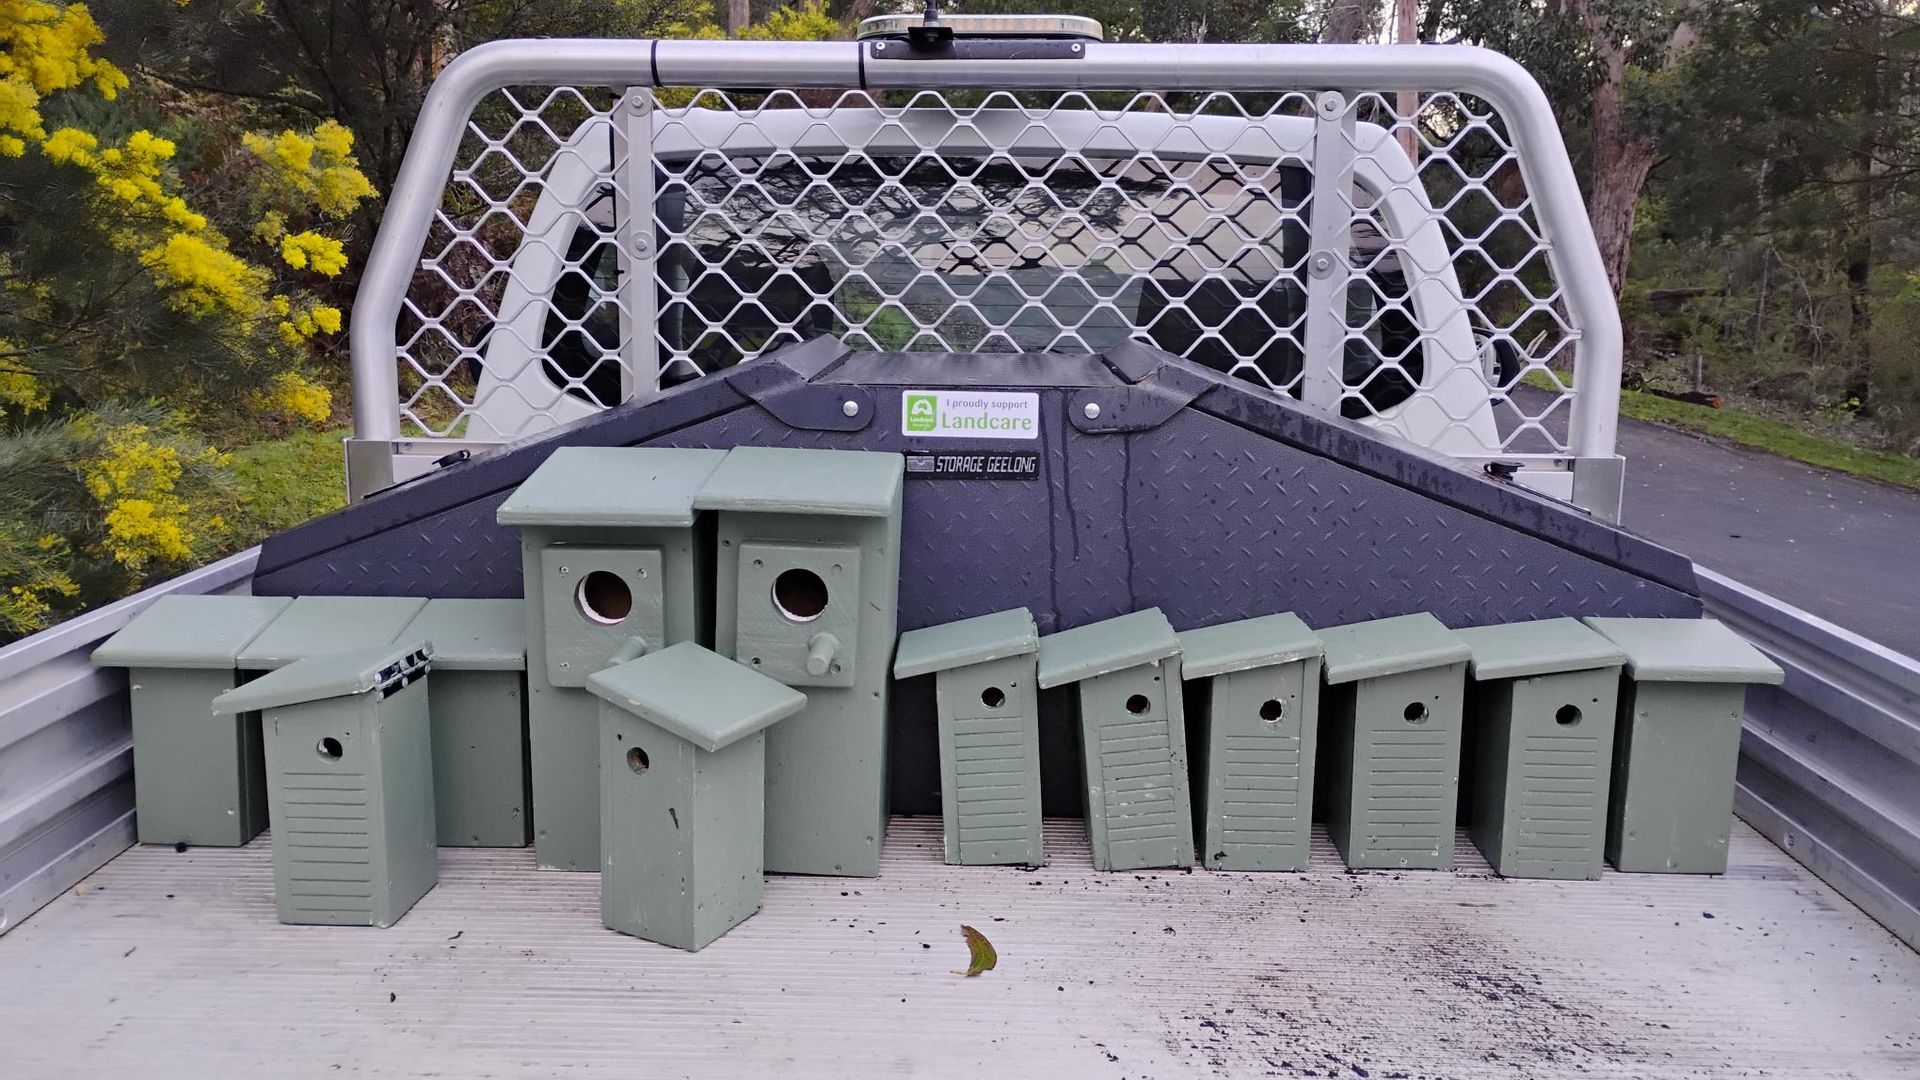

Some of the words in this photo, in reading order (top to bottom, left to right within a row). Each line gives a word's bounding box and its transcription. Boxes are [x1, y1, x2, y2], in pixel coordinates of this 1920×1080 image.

[952, 398, 989, 410] proudly
[991, 400, 1028, 411] support
[941, 412, 1032, 431] Landcare
[936, 456, 984, 473] STORAGE
[987, 456, 1037, 473] GEELONG
